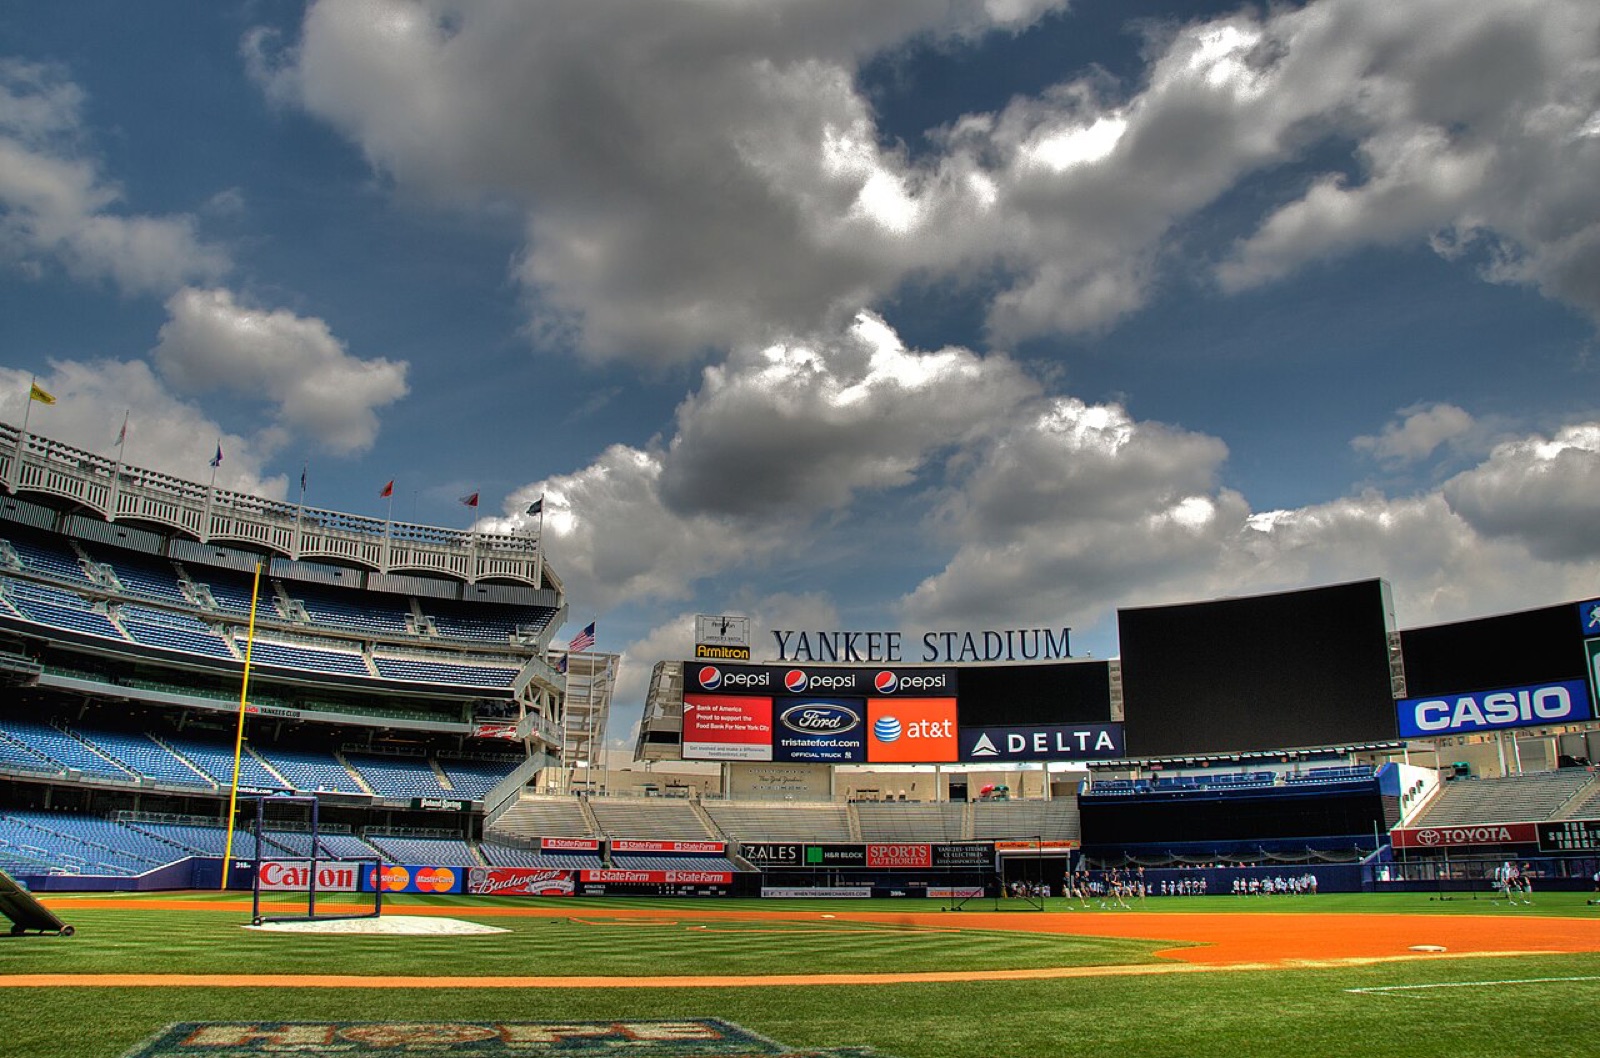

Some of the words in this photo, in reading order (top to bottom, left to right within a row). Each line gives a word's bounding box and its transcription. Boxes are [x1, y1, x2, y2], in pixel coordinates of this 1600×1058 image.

[697, 645, 749, 659] Armitron
[770, 630, 902, 662] YANKEE
[922, 627, 1073, 662] STADIUM
[724, 672, 770, 688] pepsi
[809, 674, 856, 689] pepsi
[900, 674, 946, 690] pepsi
[1414, 686, 1571, 731] CASIO
[798, 709, 842, 728] Ford
[906, 719, 952, 738] at&t
[781, 738, 860, 748] tristateford.com
[1007, 730, 1115, 753] DELTA
[1563, 821, 1585, 831] THE
[1441, 827, 1512, 843] TOYOTA
[747, 846, 797, 859] ZALES
[870, 846, 927, 858] SPORTS
[417, 875, 453, 883] MasterCard
[478, 869, 561, 894] Budweiser
[180, 1022, 726, 1047] HOPE
